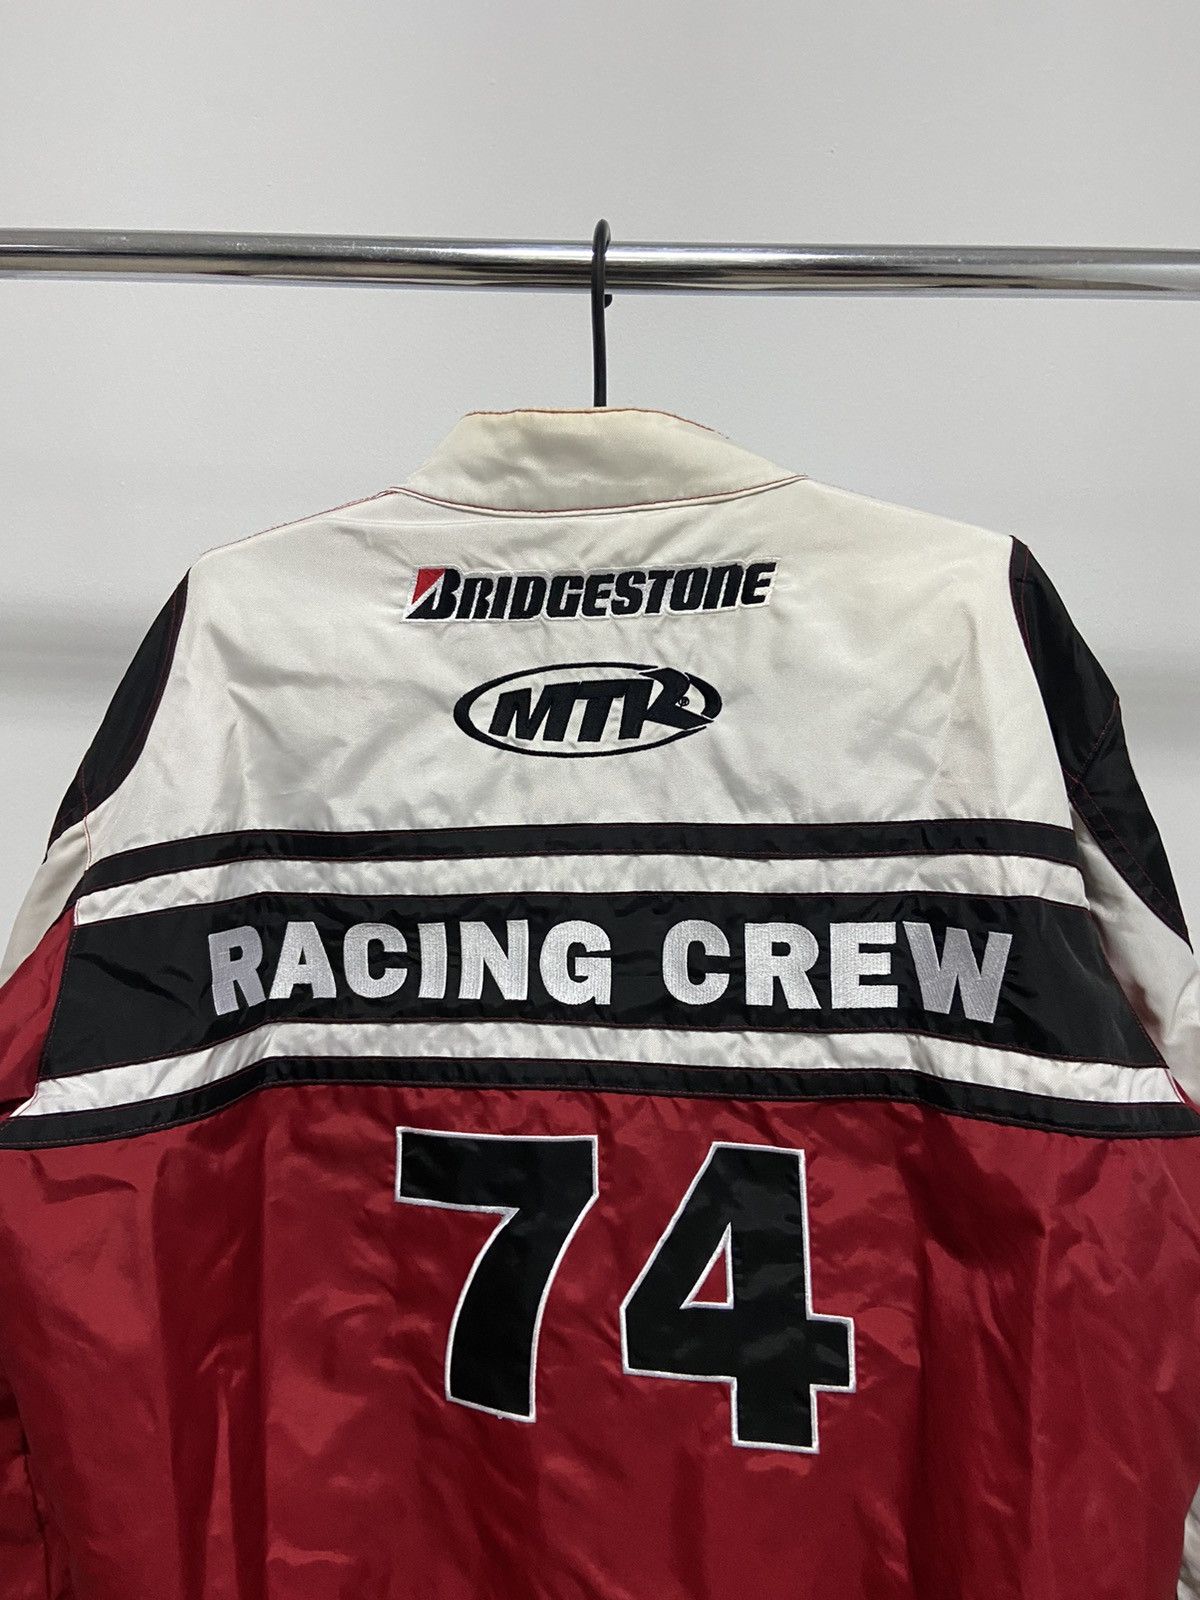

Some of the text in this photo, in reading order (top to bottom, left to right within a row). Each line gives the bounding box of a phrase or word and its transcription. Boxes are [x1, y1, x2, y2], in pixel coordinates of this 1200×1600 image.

[405, 562, 777, 620] BRIDGESTONE
[208, 919, 1013, 1024] RACING CREW
[395, 1126, 856, 1455] 74
